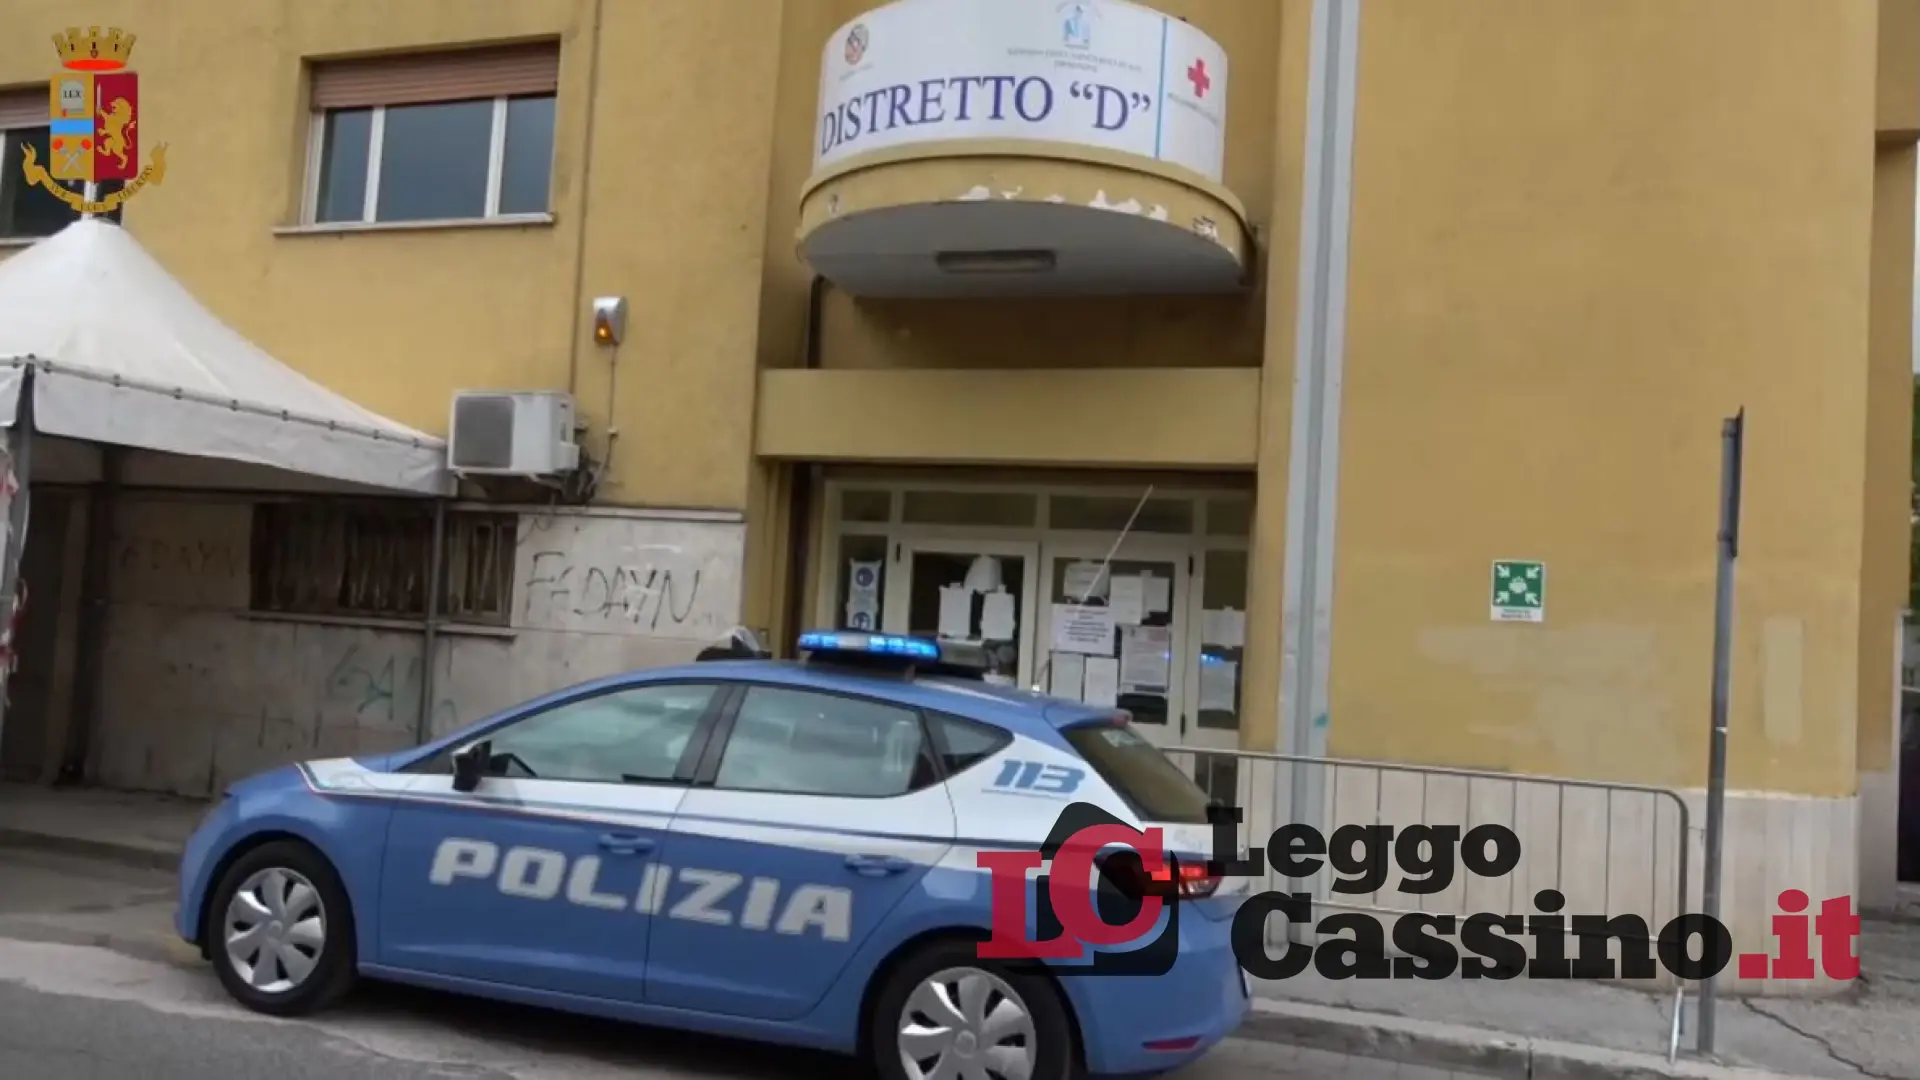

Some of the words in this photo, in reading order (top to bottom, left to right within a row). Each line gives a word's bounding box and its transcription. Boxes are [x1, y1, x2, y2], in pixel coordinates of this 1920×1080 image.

[820, 75, 1053, 157] DISTRETTO
[994, 759, 1085, 794] 113
[429, 837, 852, 943] POLIZIA
